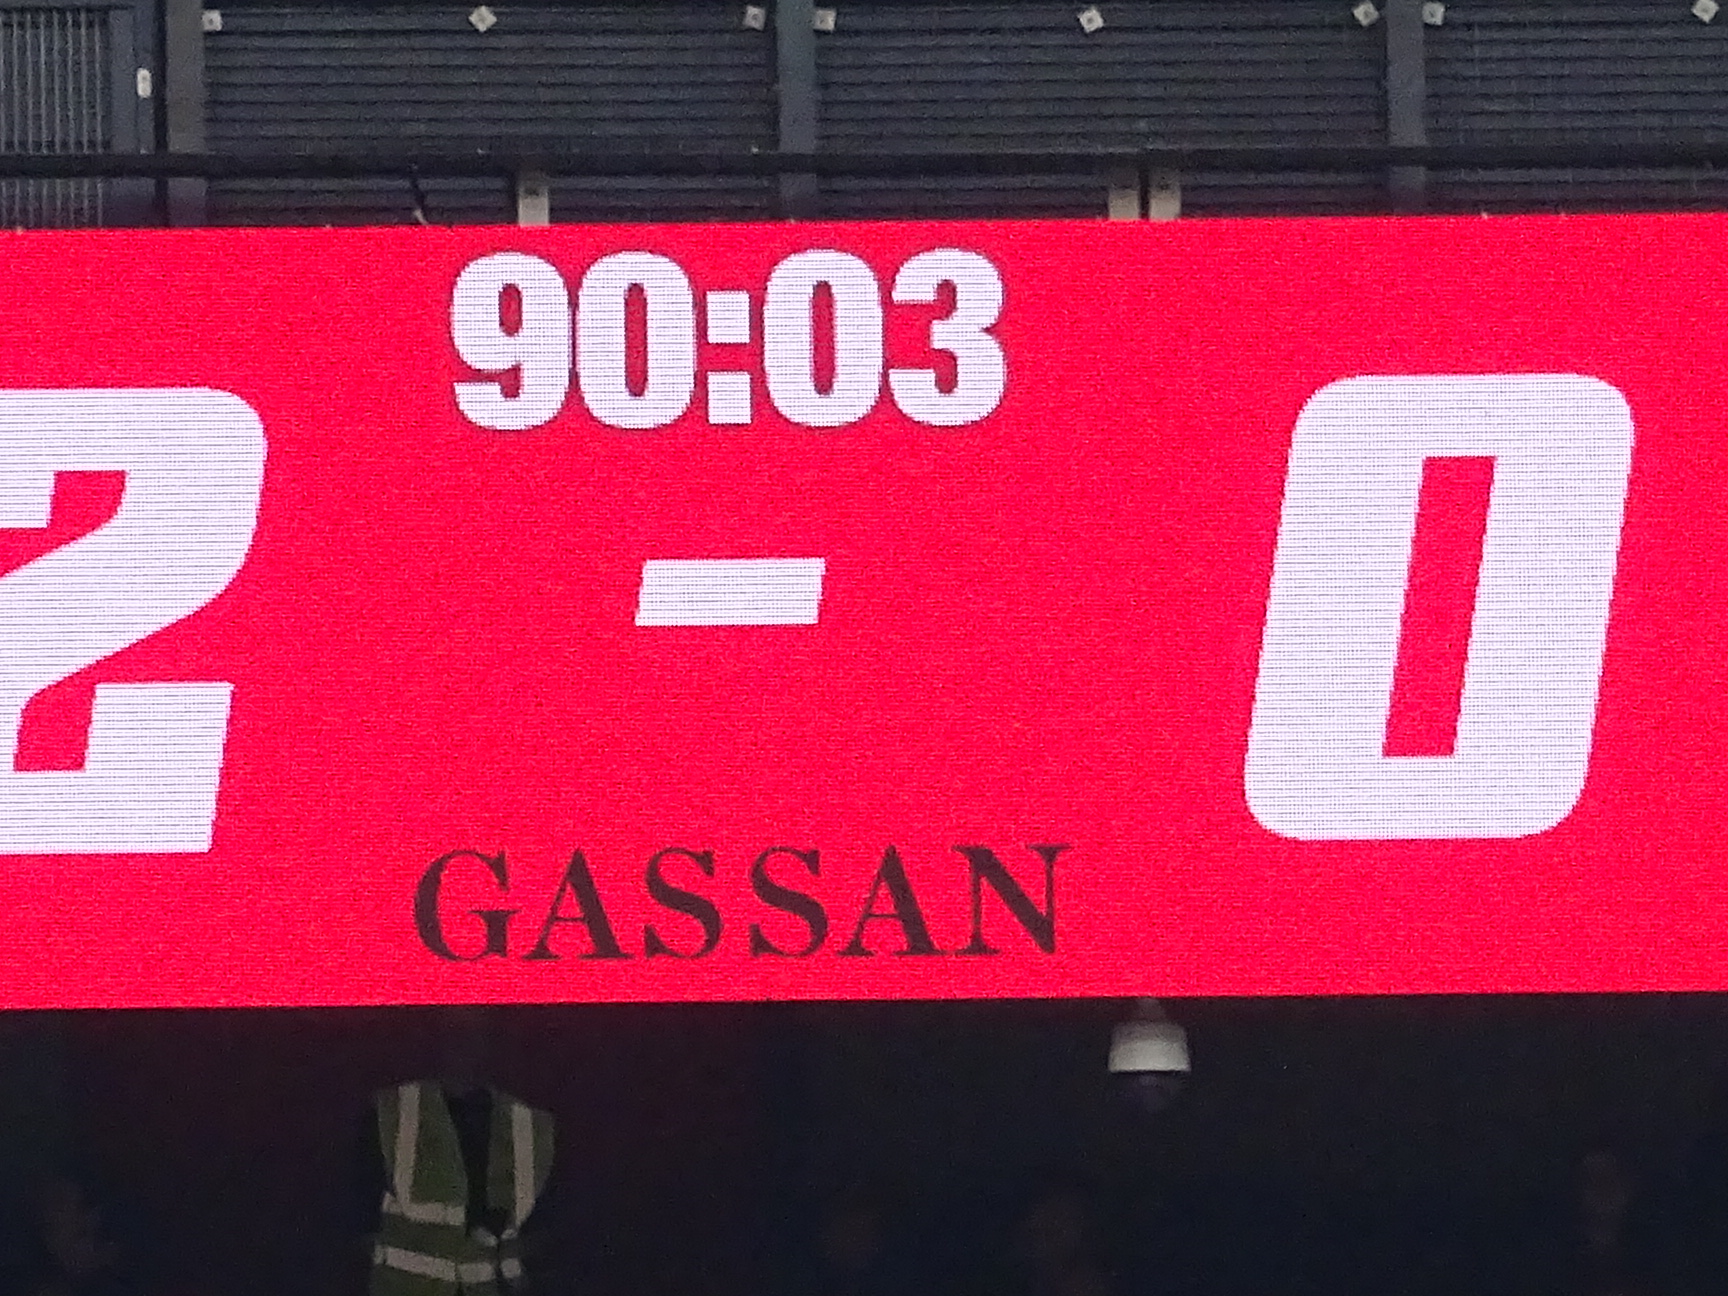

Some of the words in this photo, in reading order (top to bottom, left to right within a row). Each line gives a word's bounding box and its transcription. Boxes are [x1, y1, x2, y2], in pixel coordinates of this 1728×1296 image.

[450, 247, 1007, 431] 90:03
[1243, 372, 1636, 841] 0
[412, 844, 1071, 963] GASSAN
